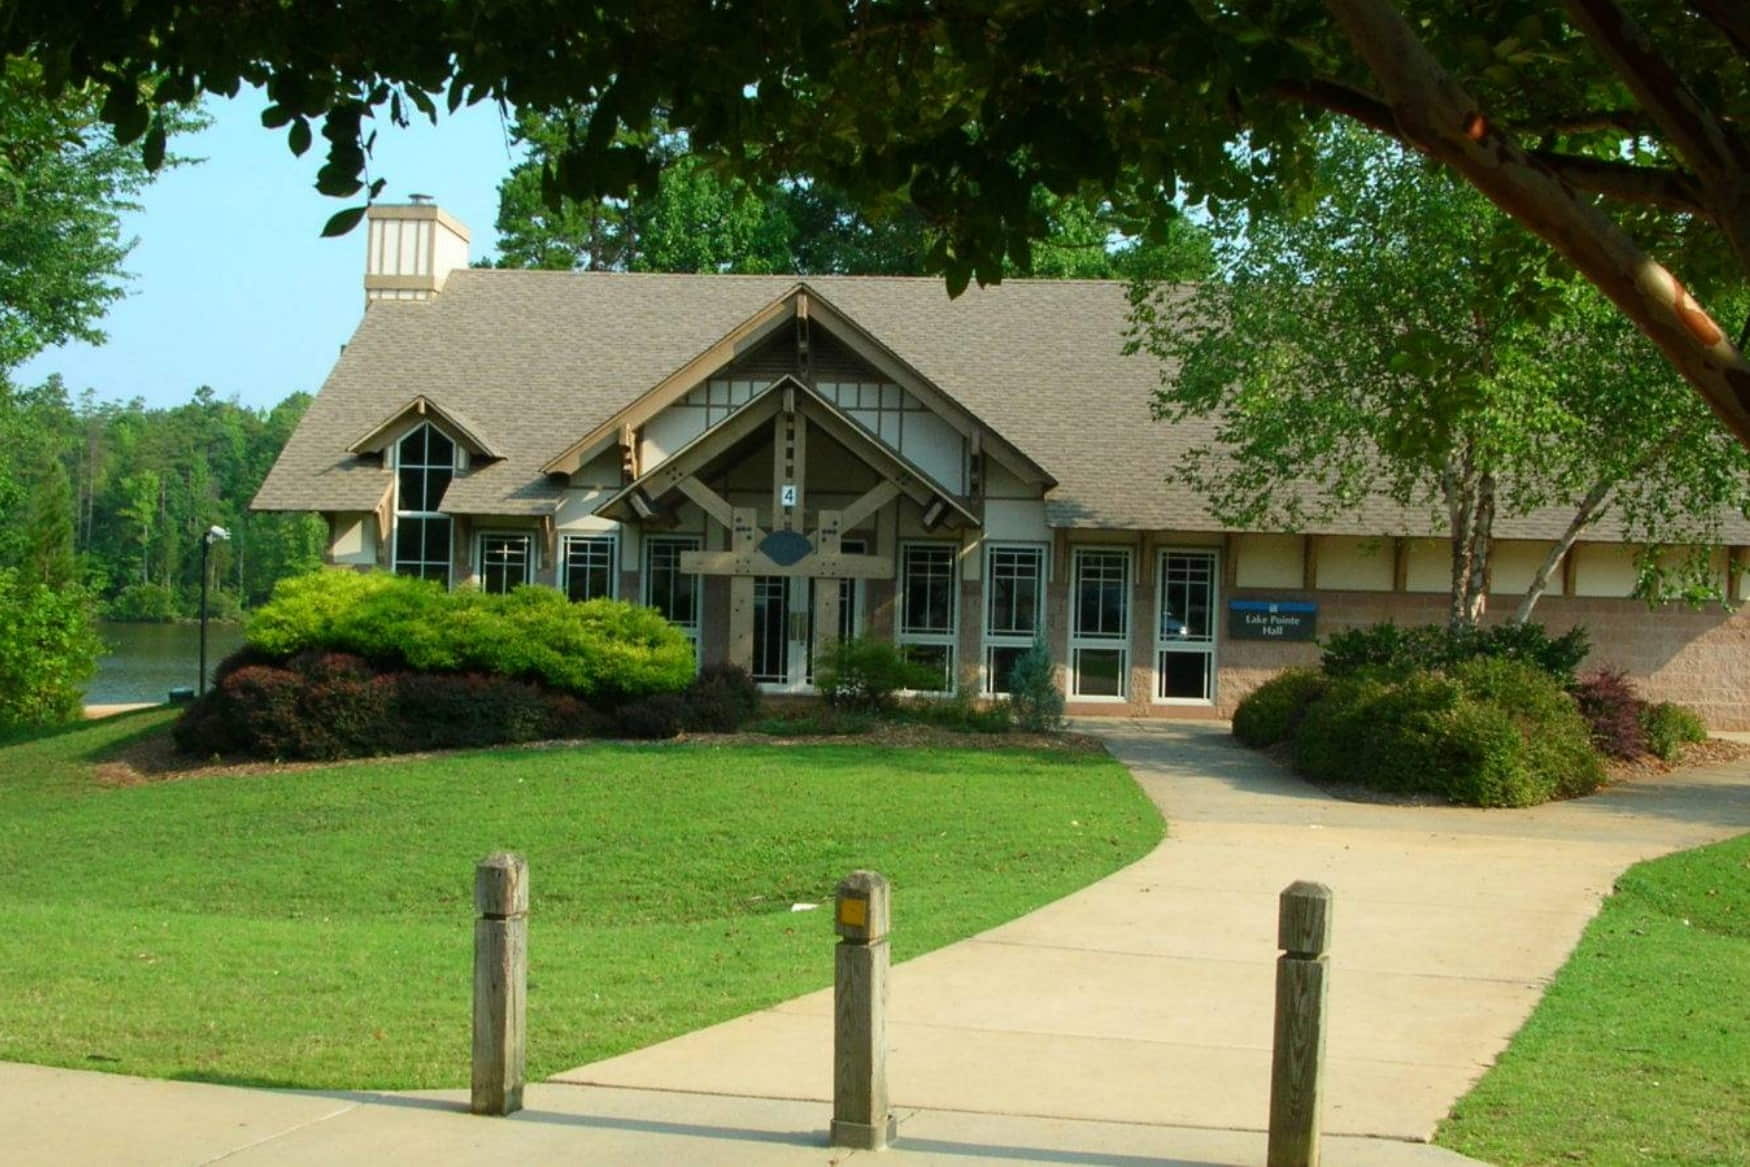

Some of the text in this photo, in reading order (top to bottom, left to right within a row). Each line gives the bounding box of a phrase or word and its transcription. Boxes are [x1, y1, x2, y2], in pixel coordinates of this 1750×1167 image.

[784, 488, 793, 503] 4
[1246, 615, 1300, 625] Lake Pointe
[1262, 626, 1283, 635] Hall
